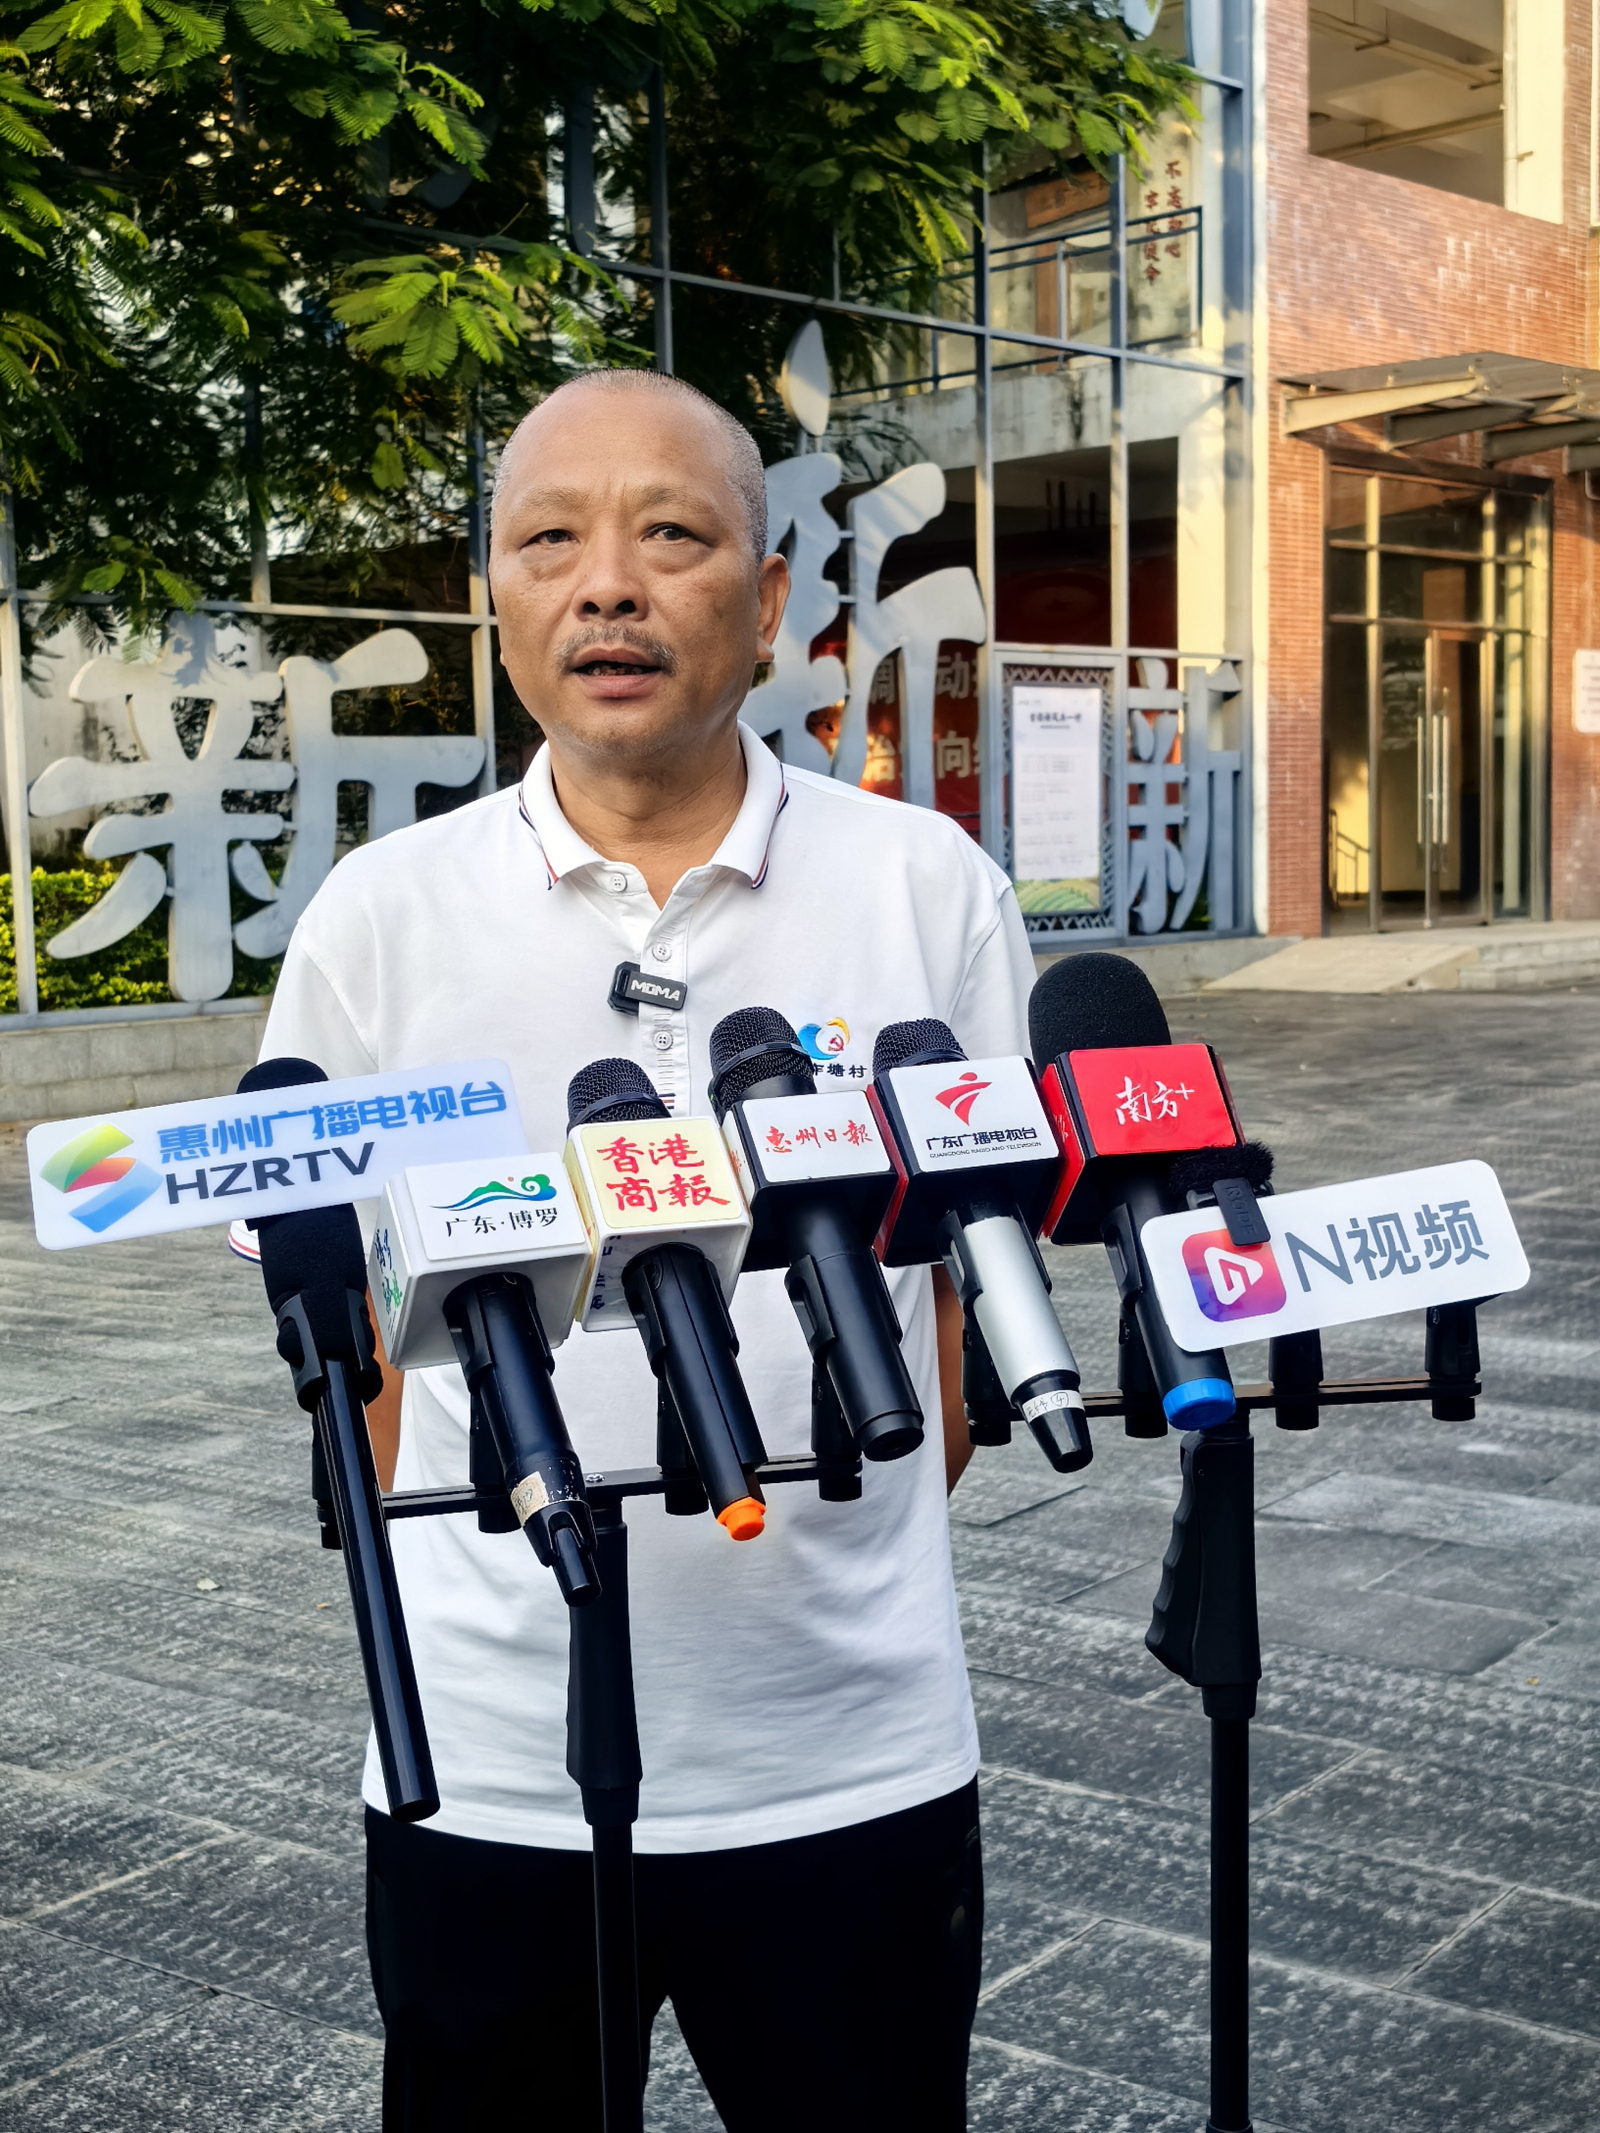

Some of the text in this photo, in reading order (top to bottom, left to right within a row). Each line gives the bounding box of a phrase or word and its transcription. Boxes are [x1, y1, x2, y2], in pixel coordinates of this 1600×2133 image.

[29, 608, 486, 1001] 新
[1127, 656, 1242, 935] 新
[630, 979, 681, 1002] MOMA
[157, 1080, 509, 1165] 惠州广播电视台
[597, 1133, 705, 1174] 香港
[926, 1126, 1038, 1150] 广东广播电视台
[165, 1141, 378, 1205] HZRTV
[1283, 1199, 1490, 1293] N视频
